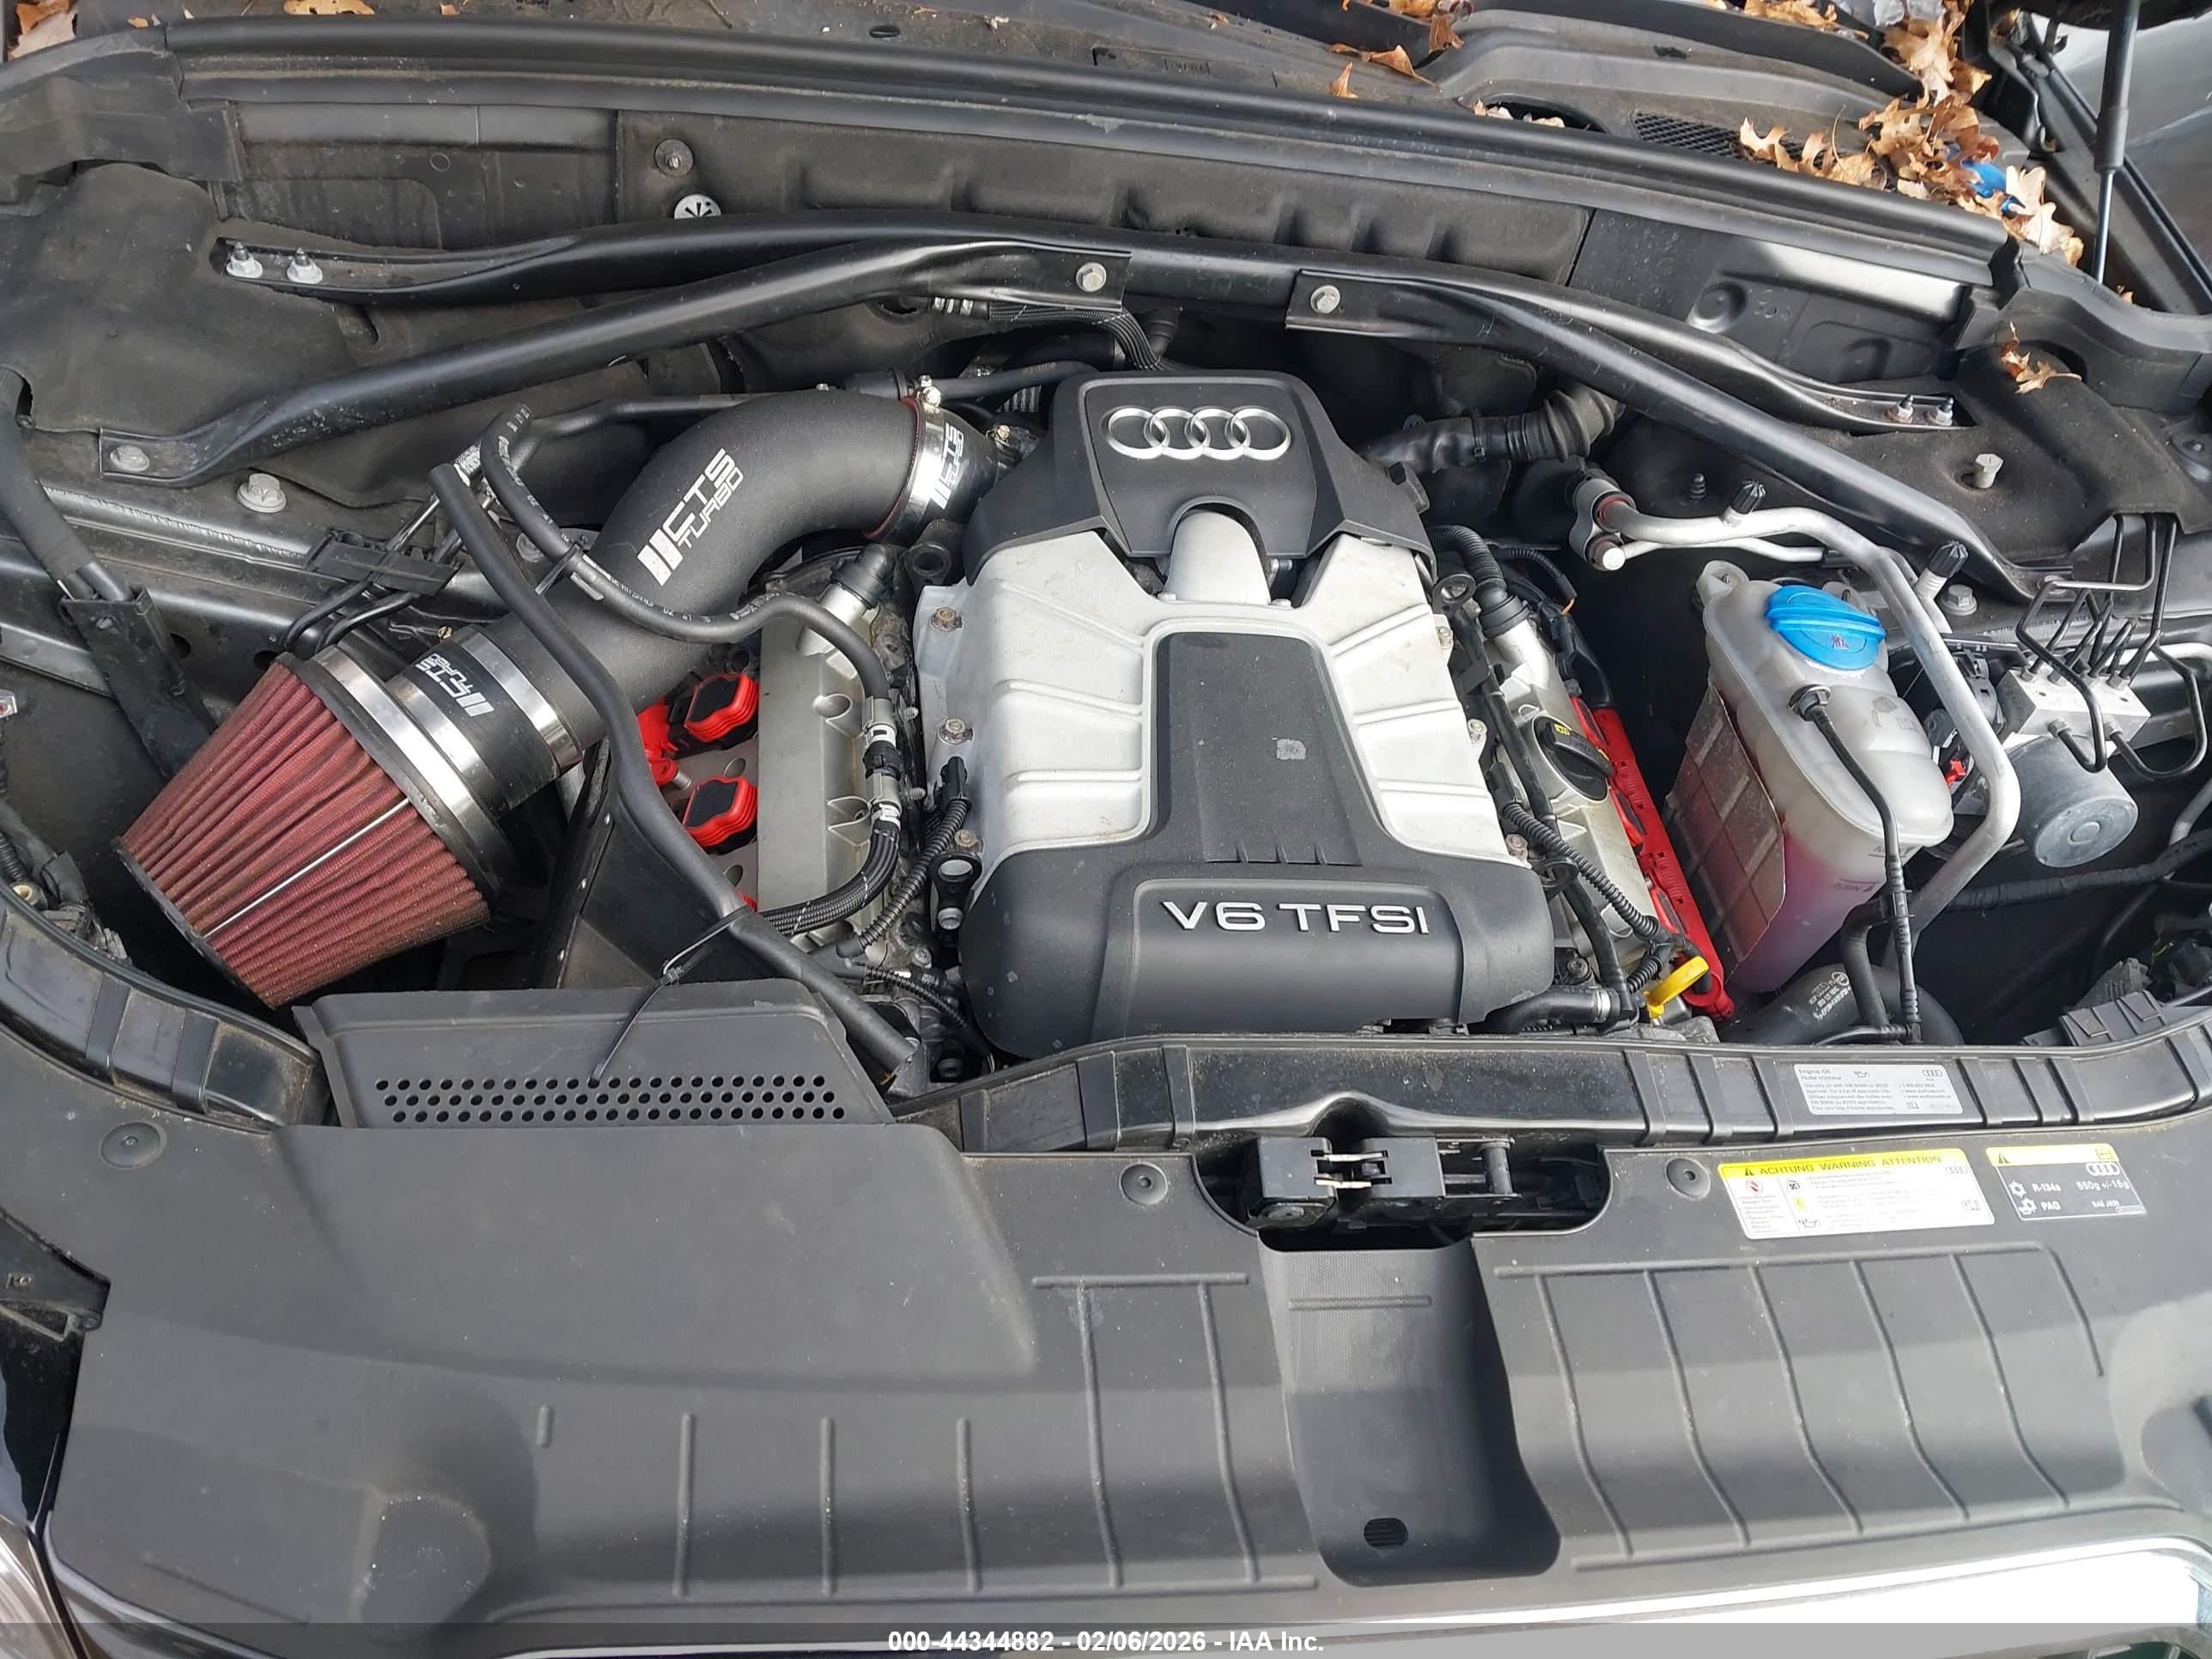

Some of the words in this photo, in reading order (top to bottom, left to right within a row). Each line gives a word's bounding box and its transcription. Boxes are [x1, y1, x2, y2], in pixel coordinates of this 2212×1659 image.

[662, 448, 735, 542] CTS
[678, 467, 744, 549] TURBO
[415, 664, 466, 697] CTS
[428, 653, 473, 693] TURBO
[1161, 901, 1266, 931] V6
[1277, 903, 1430, 935] TFSI
[1760, 1164, 1814, 1176] ACHTUNG
[1819, 1159, 1875, 1170] WARNING
[1882, 1156, 1942, 1166] ATTENTION
